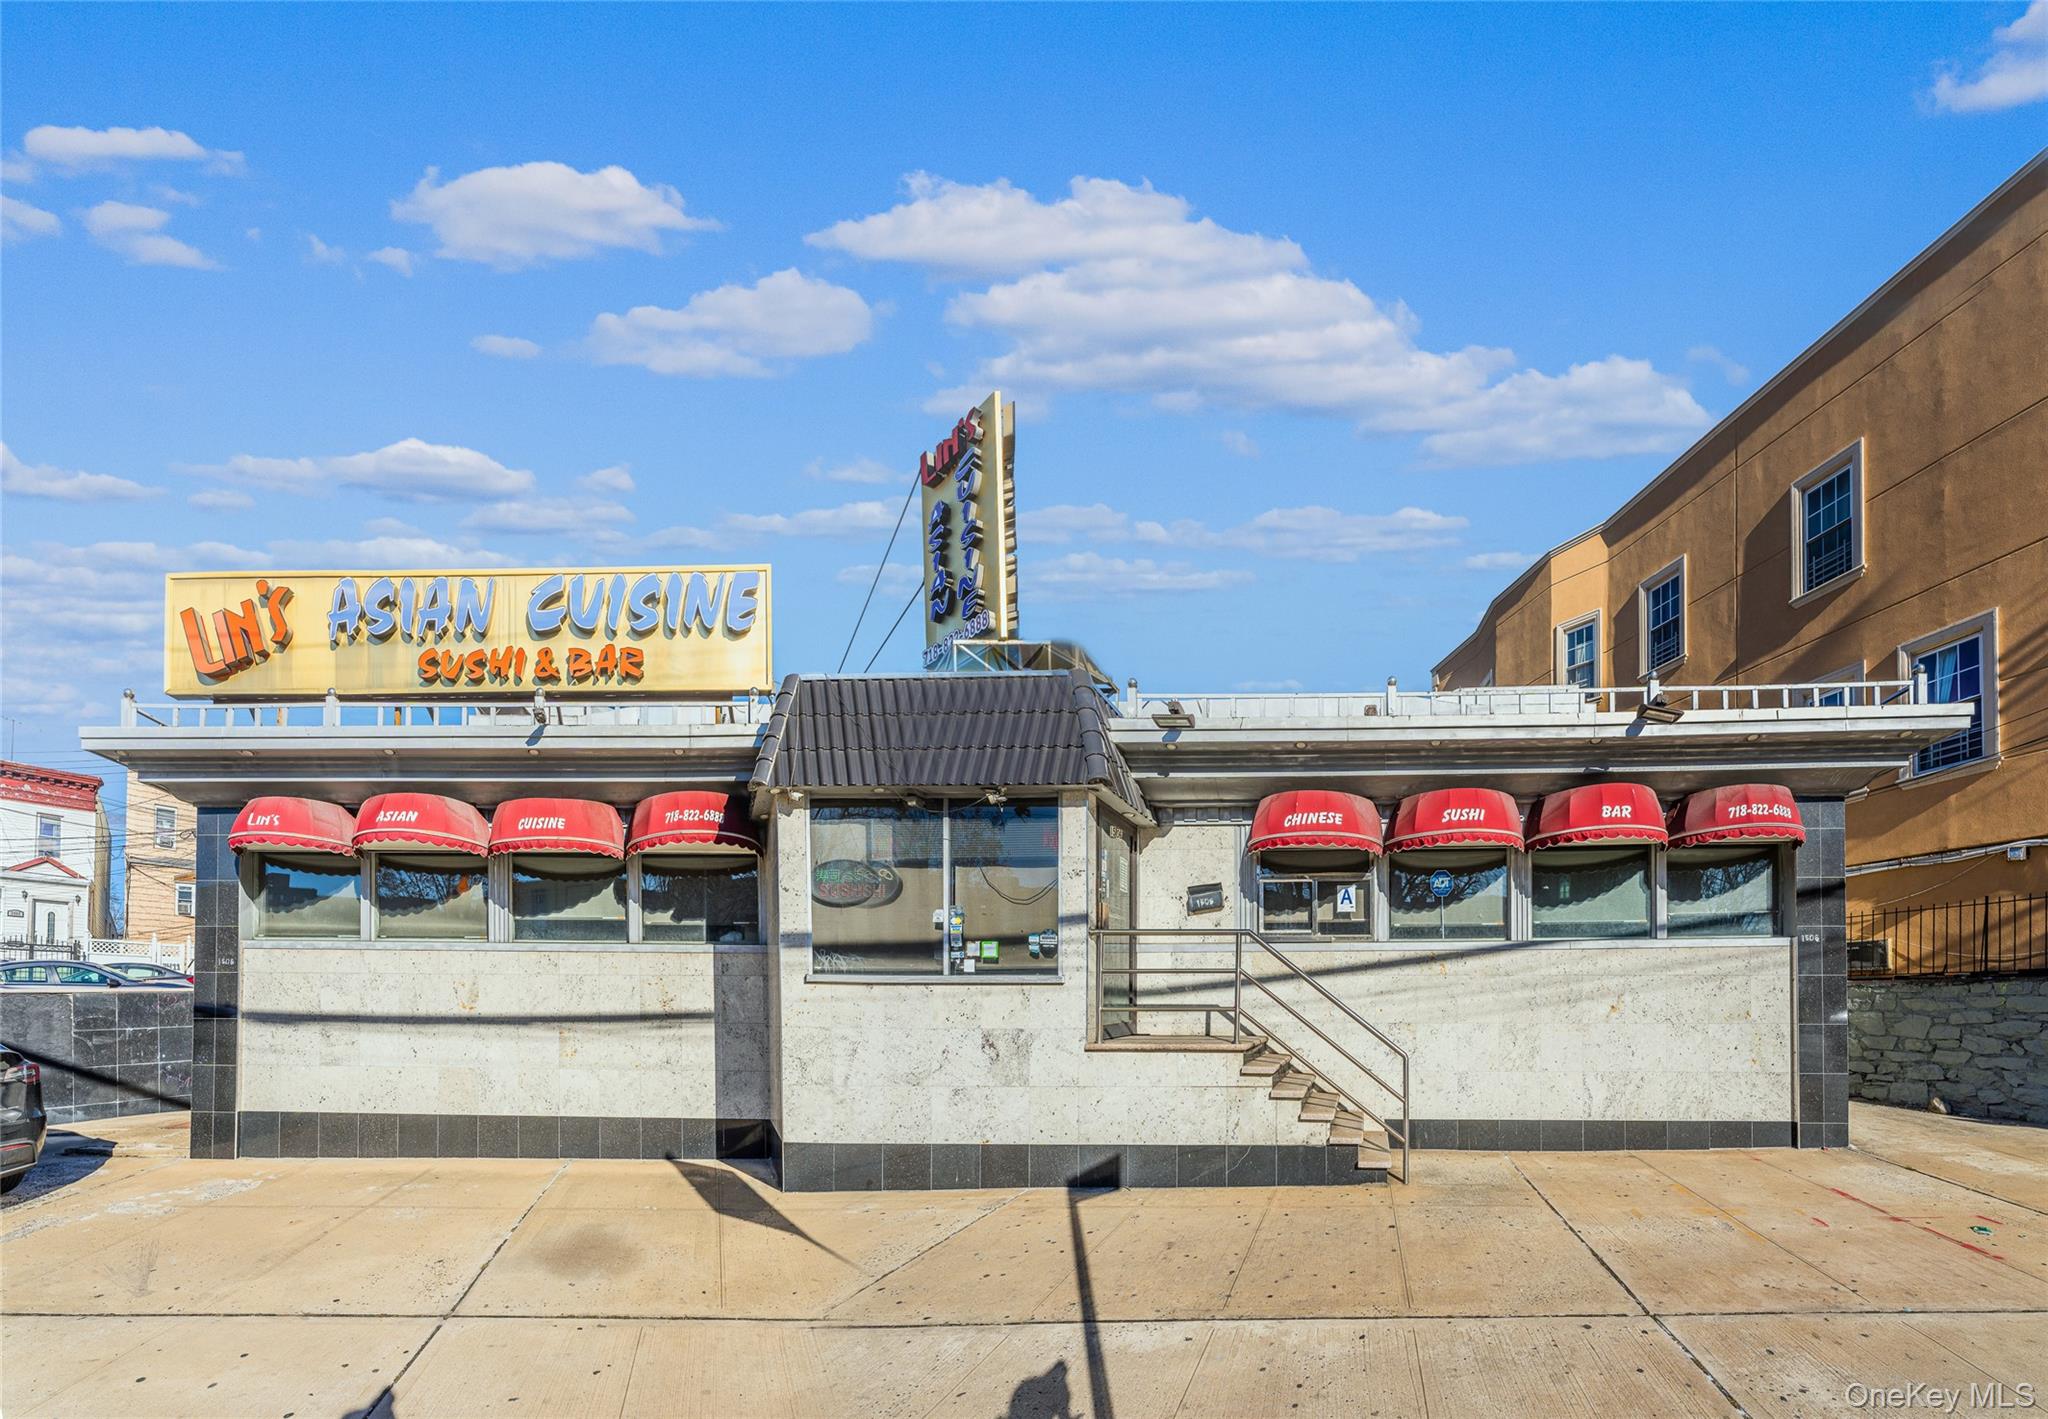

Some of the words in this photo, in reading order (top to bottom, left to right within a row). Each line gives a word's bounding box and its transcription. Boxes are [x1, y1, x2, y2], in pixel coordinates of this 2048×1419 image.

[954, 447, 982, 620] CUISINE
[928, 500, 951, 622] ASIAN
[327, 577, 497, 645] ASIAN
[527, 571, 760, 636] CUISINE
[417, 645, 528, 682] SUSHI
[533, 647, 561, 682] &
[567, 643, 645, 682] BAR
[375, 810, 419, 822] ASIAN
[1283, 811, 1343, 827] CHINESE
[1441, 808, 1486, 823] SUSHI
[1601, 804, 1632, 819] BAR
[1727, 803, 1793, 819] 718-822-6888
[517, 817, 566, 830] CUISINE
[1432, 876, 1451, 889] ADT
[1340, 888, 1353, 905] A
